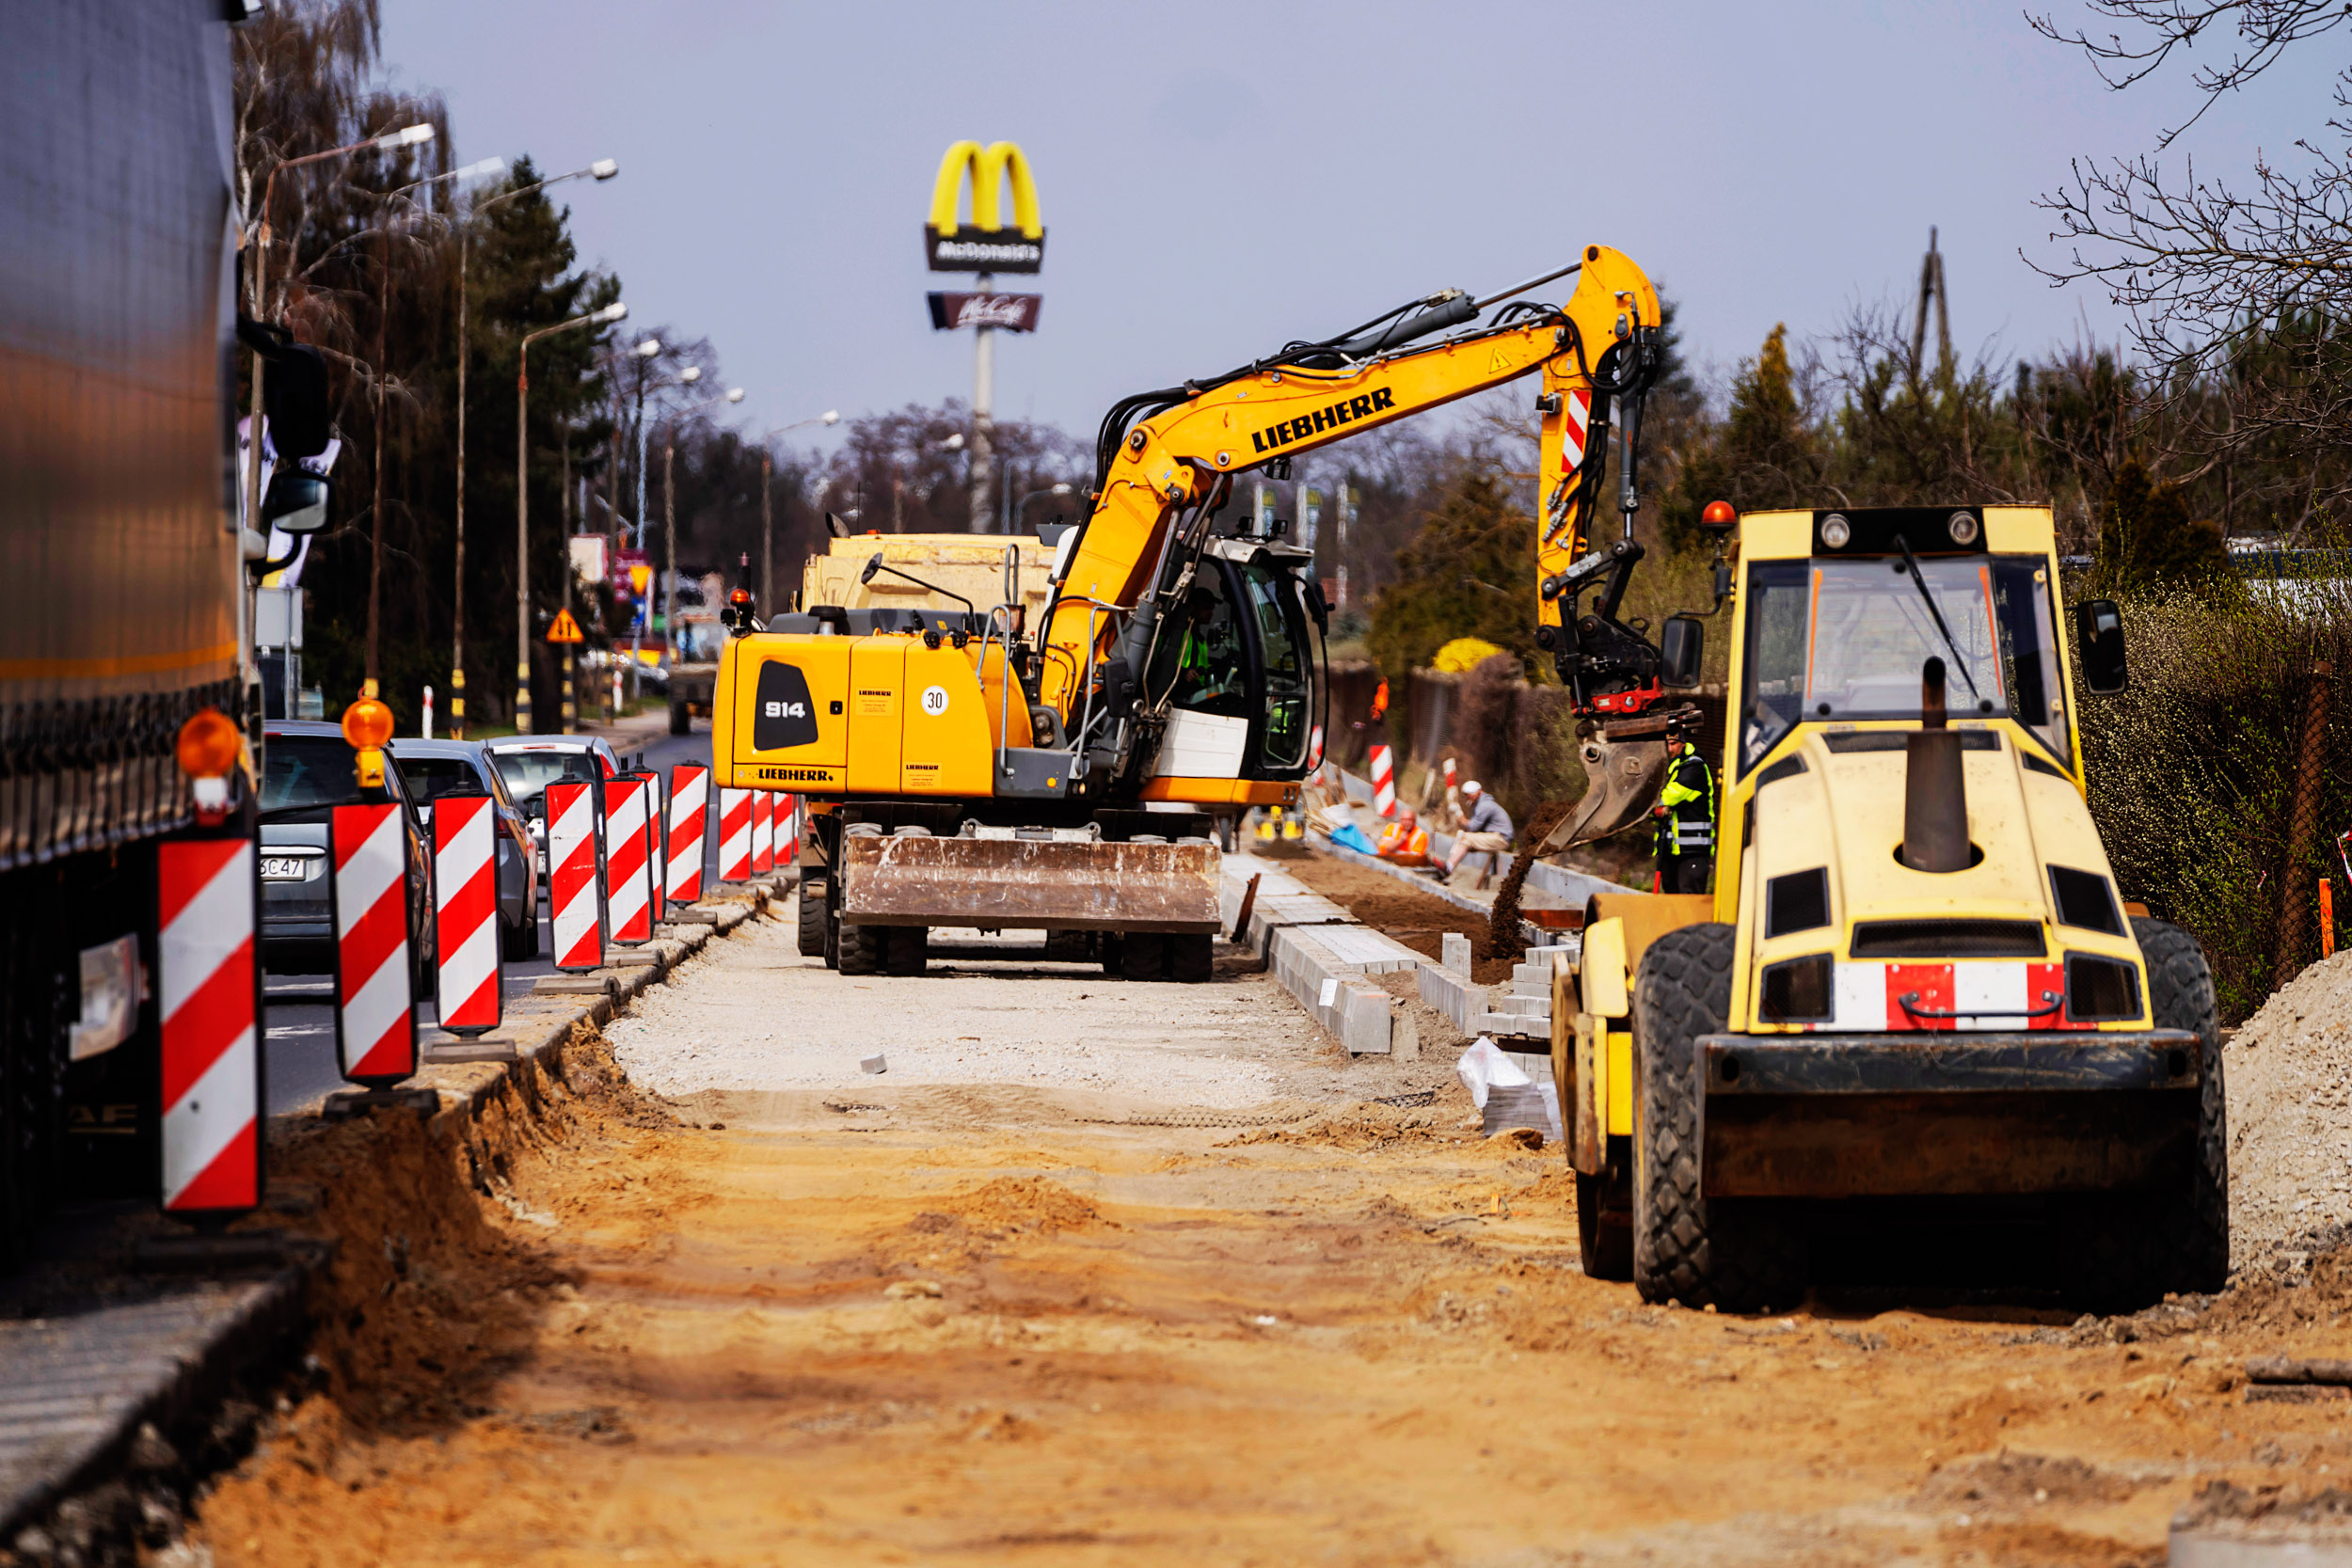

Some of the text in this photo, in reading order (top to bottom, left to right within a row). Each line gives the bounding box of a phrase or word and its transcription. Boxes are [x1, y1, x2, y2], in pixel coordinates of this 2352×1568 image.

[936, 241, 1040, 261] McDonald's
[1251, 387, 1396, 453] LIEBHERR
[928, 692, 943, 708] 30
[765, 701, 806, 719] 914
[758, 768, 828, 782] LIEBHERR
